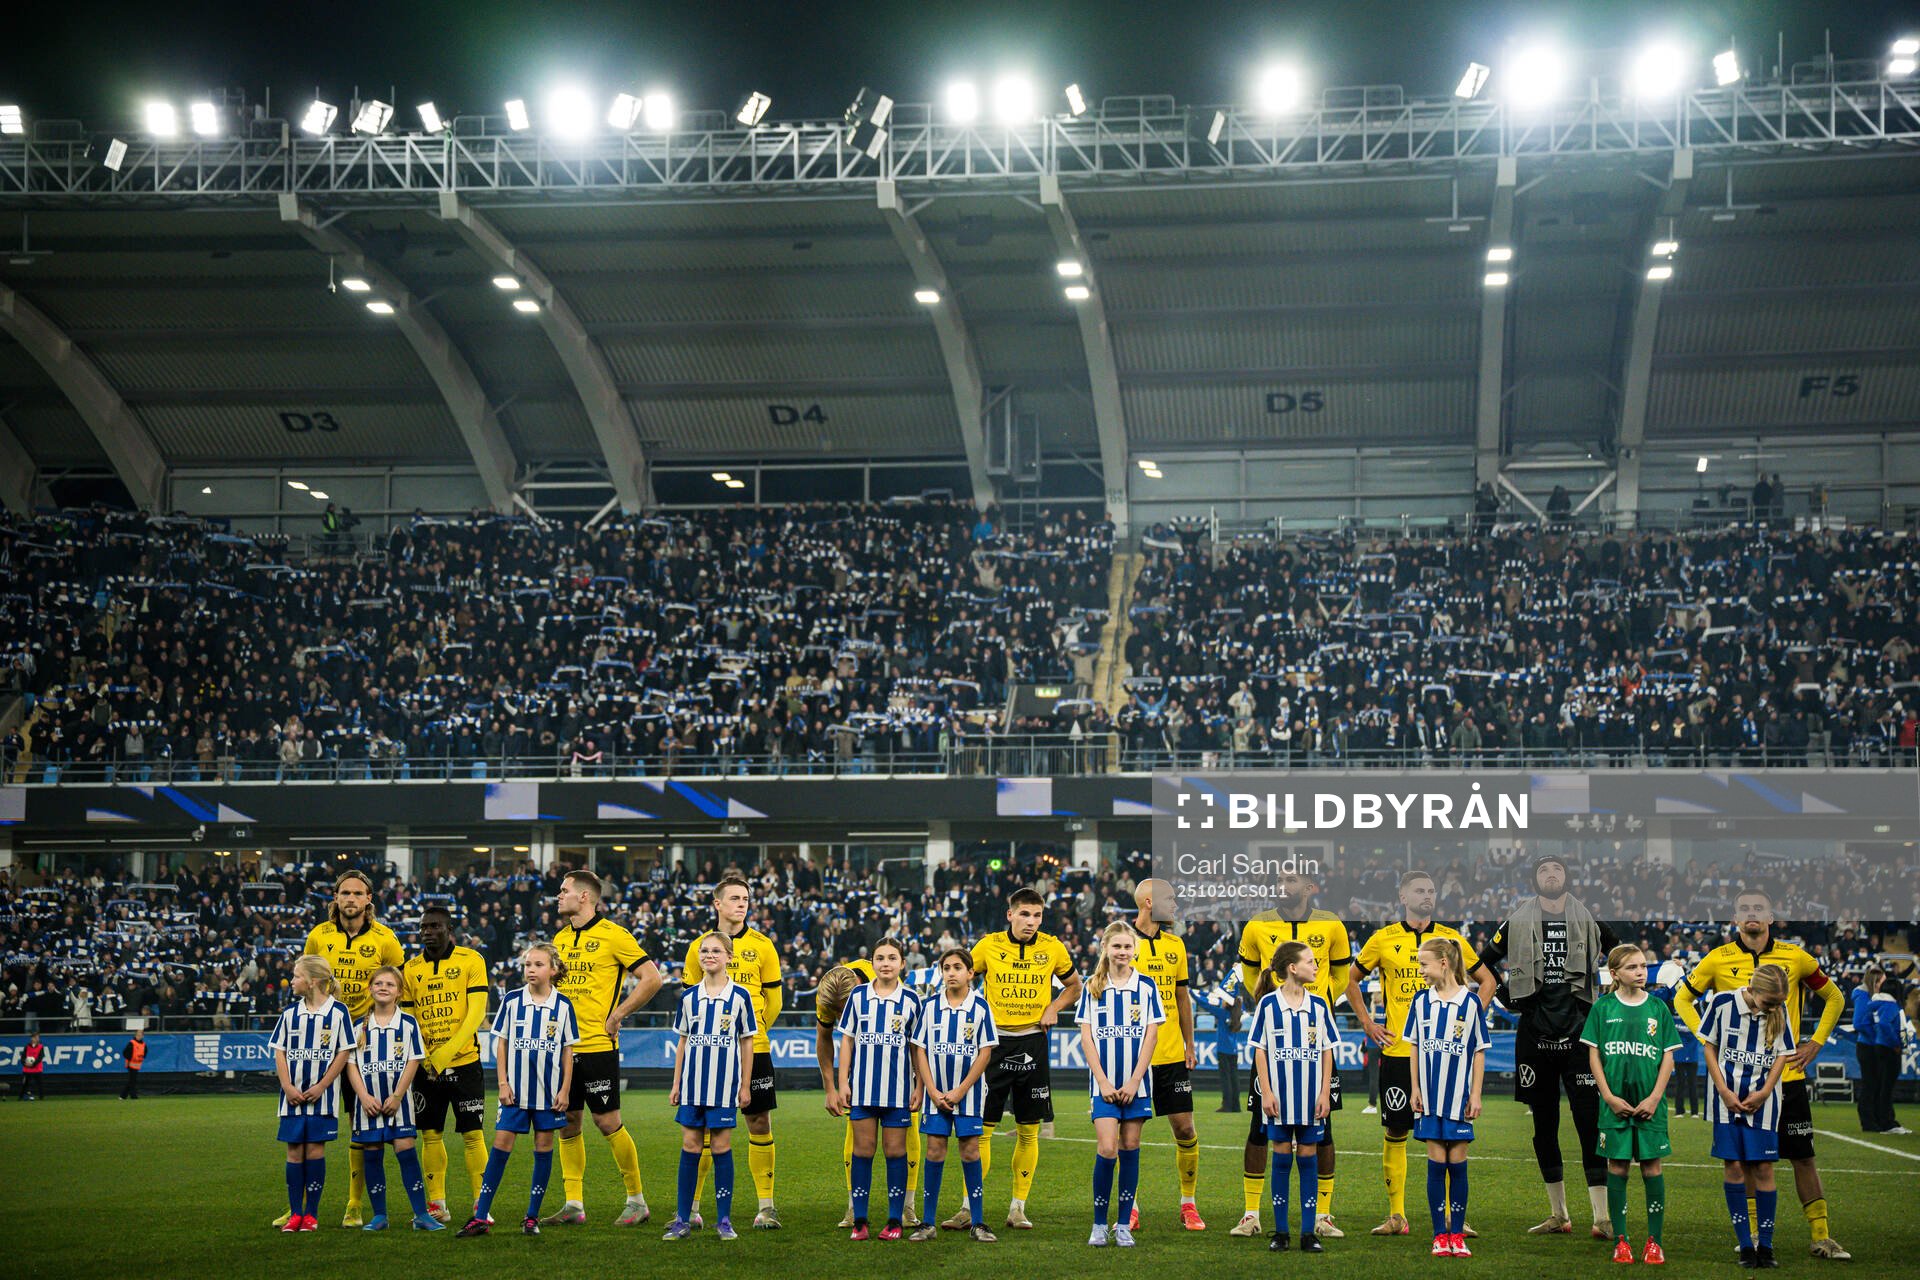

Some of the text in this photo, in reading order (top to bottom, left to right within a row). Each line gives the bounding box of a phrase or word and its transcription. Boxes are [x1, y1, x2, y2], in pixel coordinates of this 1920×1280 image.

[1266, 391, 1324, 413] D5
[768, 404, 829, 425] D4
[279, 412, 340, 433] D3
[1547, 930, 1566, 938] MAXI
[1543, 942, 1567, 953] ELL
[338, 957, 355, 966] MAXI
[1012, 962, 1031, 970] MAXI
[995, 973, 1046, 985] MELLBY
[1394, 968, 1422, 979] MEL
[427, 983, 444, 991] MAXI
[1001, 985, 1038, 999] GÅRD
[415, 992, 460, 1008] MELLBY
[421, 1004, 453, 1021] GÅRD
[1006, 1009, 1031, 1017] Sparbank
[859, 1033, 902, 1045] SERNEKE
[1096, 1026, 1143, 1039] SERNEKE
[514, 1038, 556, 1051] SERNEKE
[689, 1035, 731, 1047] SERNEKE
[1423, 1039, 1465, 1055] SRNEKE
[222, 1045, 277, 1060] STEN
[287, 1049, 332, 1061] SERNEKE
[1273, 1048, 1320, 1061] SERNEKE
[1604, 1041, 1660, 1060] SERNEKE
[1724, 1048, 1775, 1068] SERNEKE
[362, 1060, 406, 1075] SERNEKE
